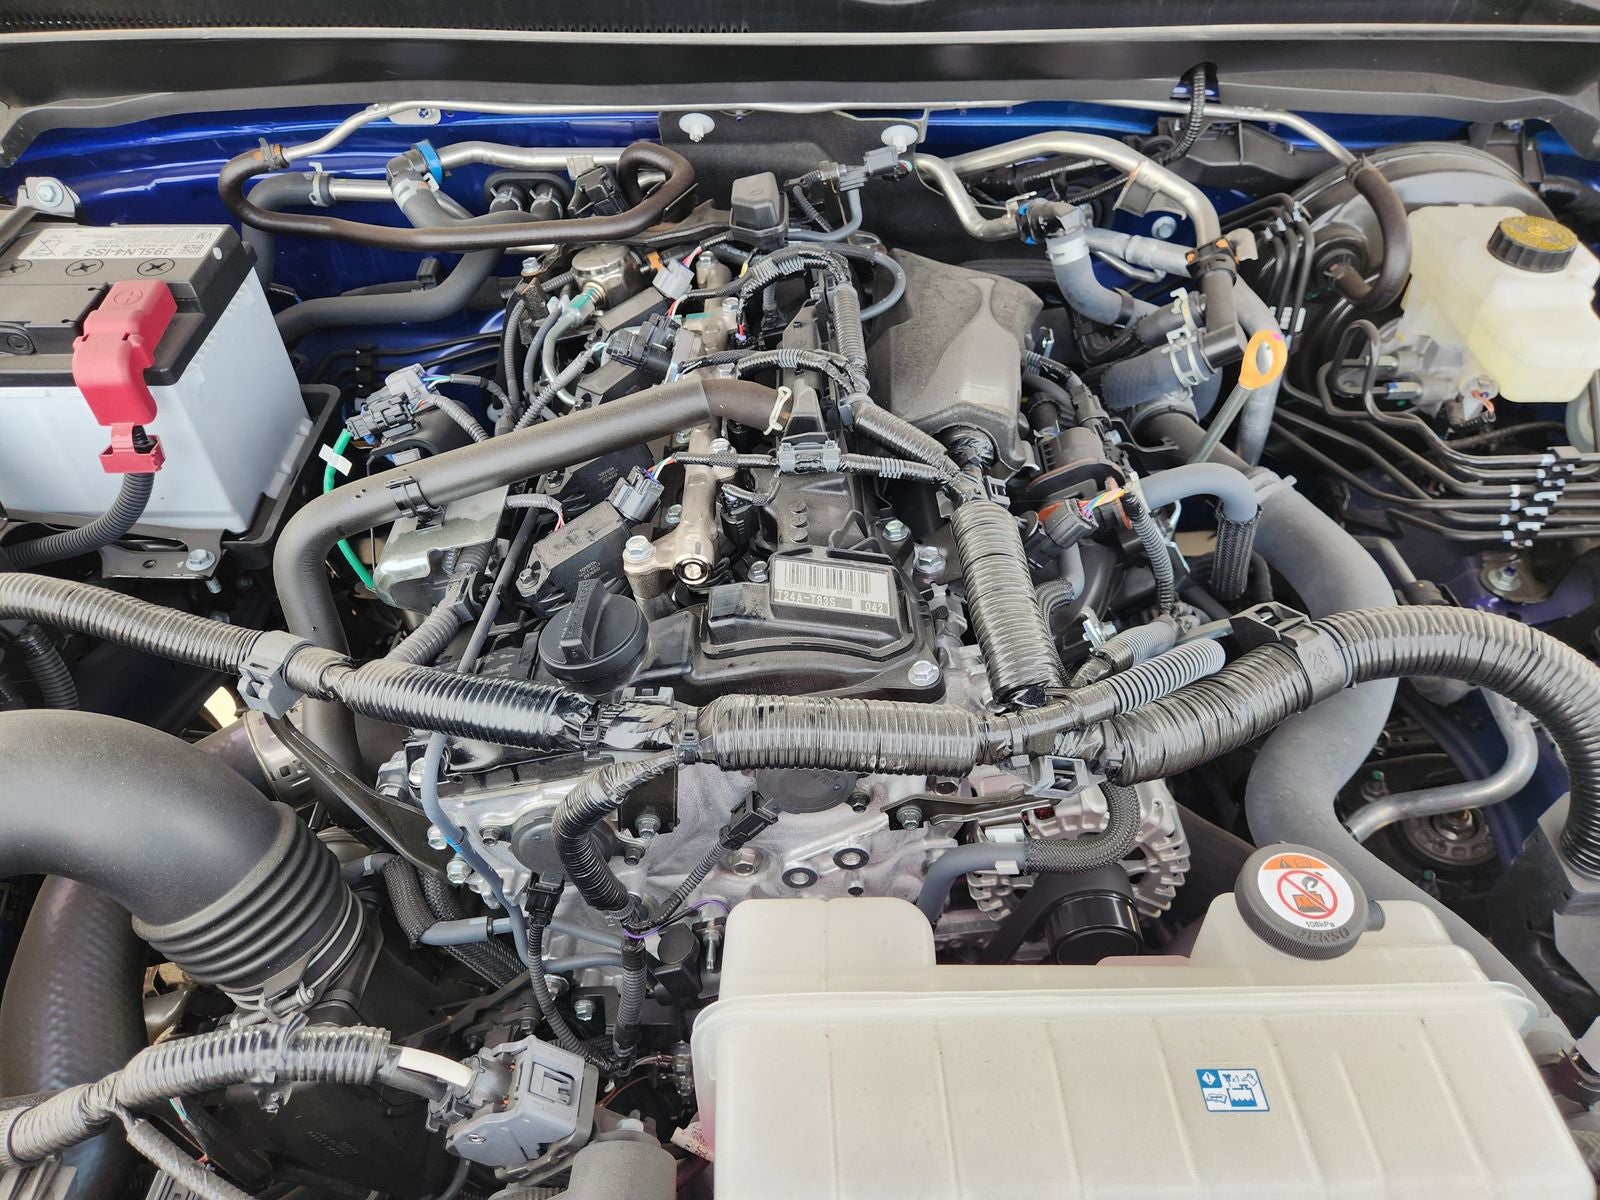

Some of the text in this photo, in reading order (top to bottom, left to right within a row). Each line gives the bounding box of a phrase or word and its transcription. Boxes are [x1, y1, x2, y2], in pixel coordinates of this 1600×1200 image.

[579, 561, 598, 573] TOYOTA
[777, 590, 836, 608] T24A-T83S
[864, 601, 884, 613] 042
[1295, 928, 1350, 943] DENSO
